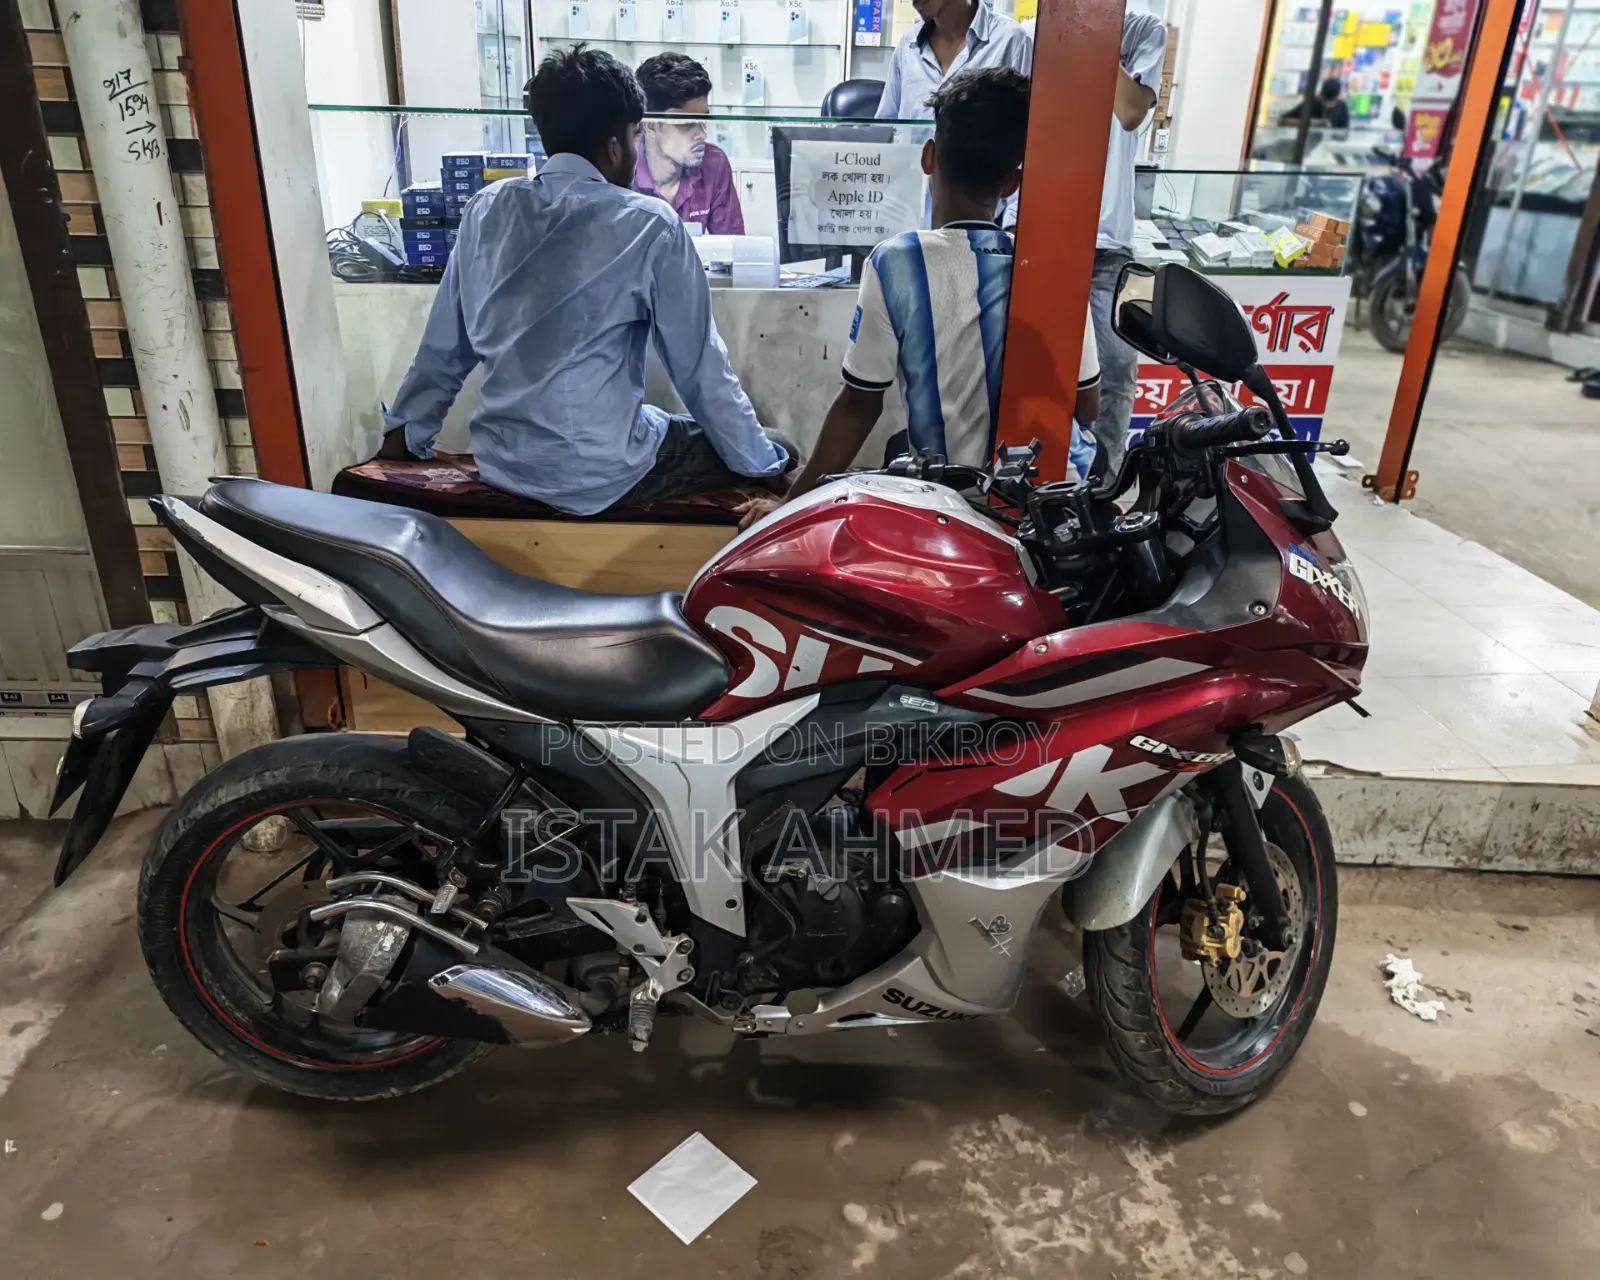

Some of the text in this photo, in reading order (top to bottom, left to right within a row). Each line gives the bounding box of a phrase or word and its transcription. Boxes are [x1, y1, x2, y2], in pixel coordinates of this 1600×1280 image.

[834, 152, 881, 166] I-Cloud
[828, 189, 884, 206] Apple ID
